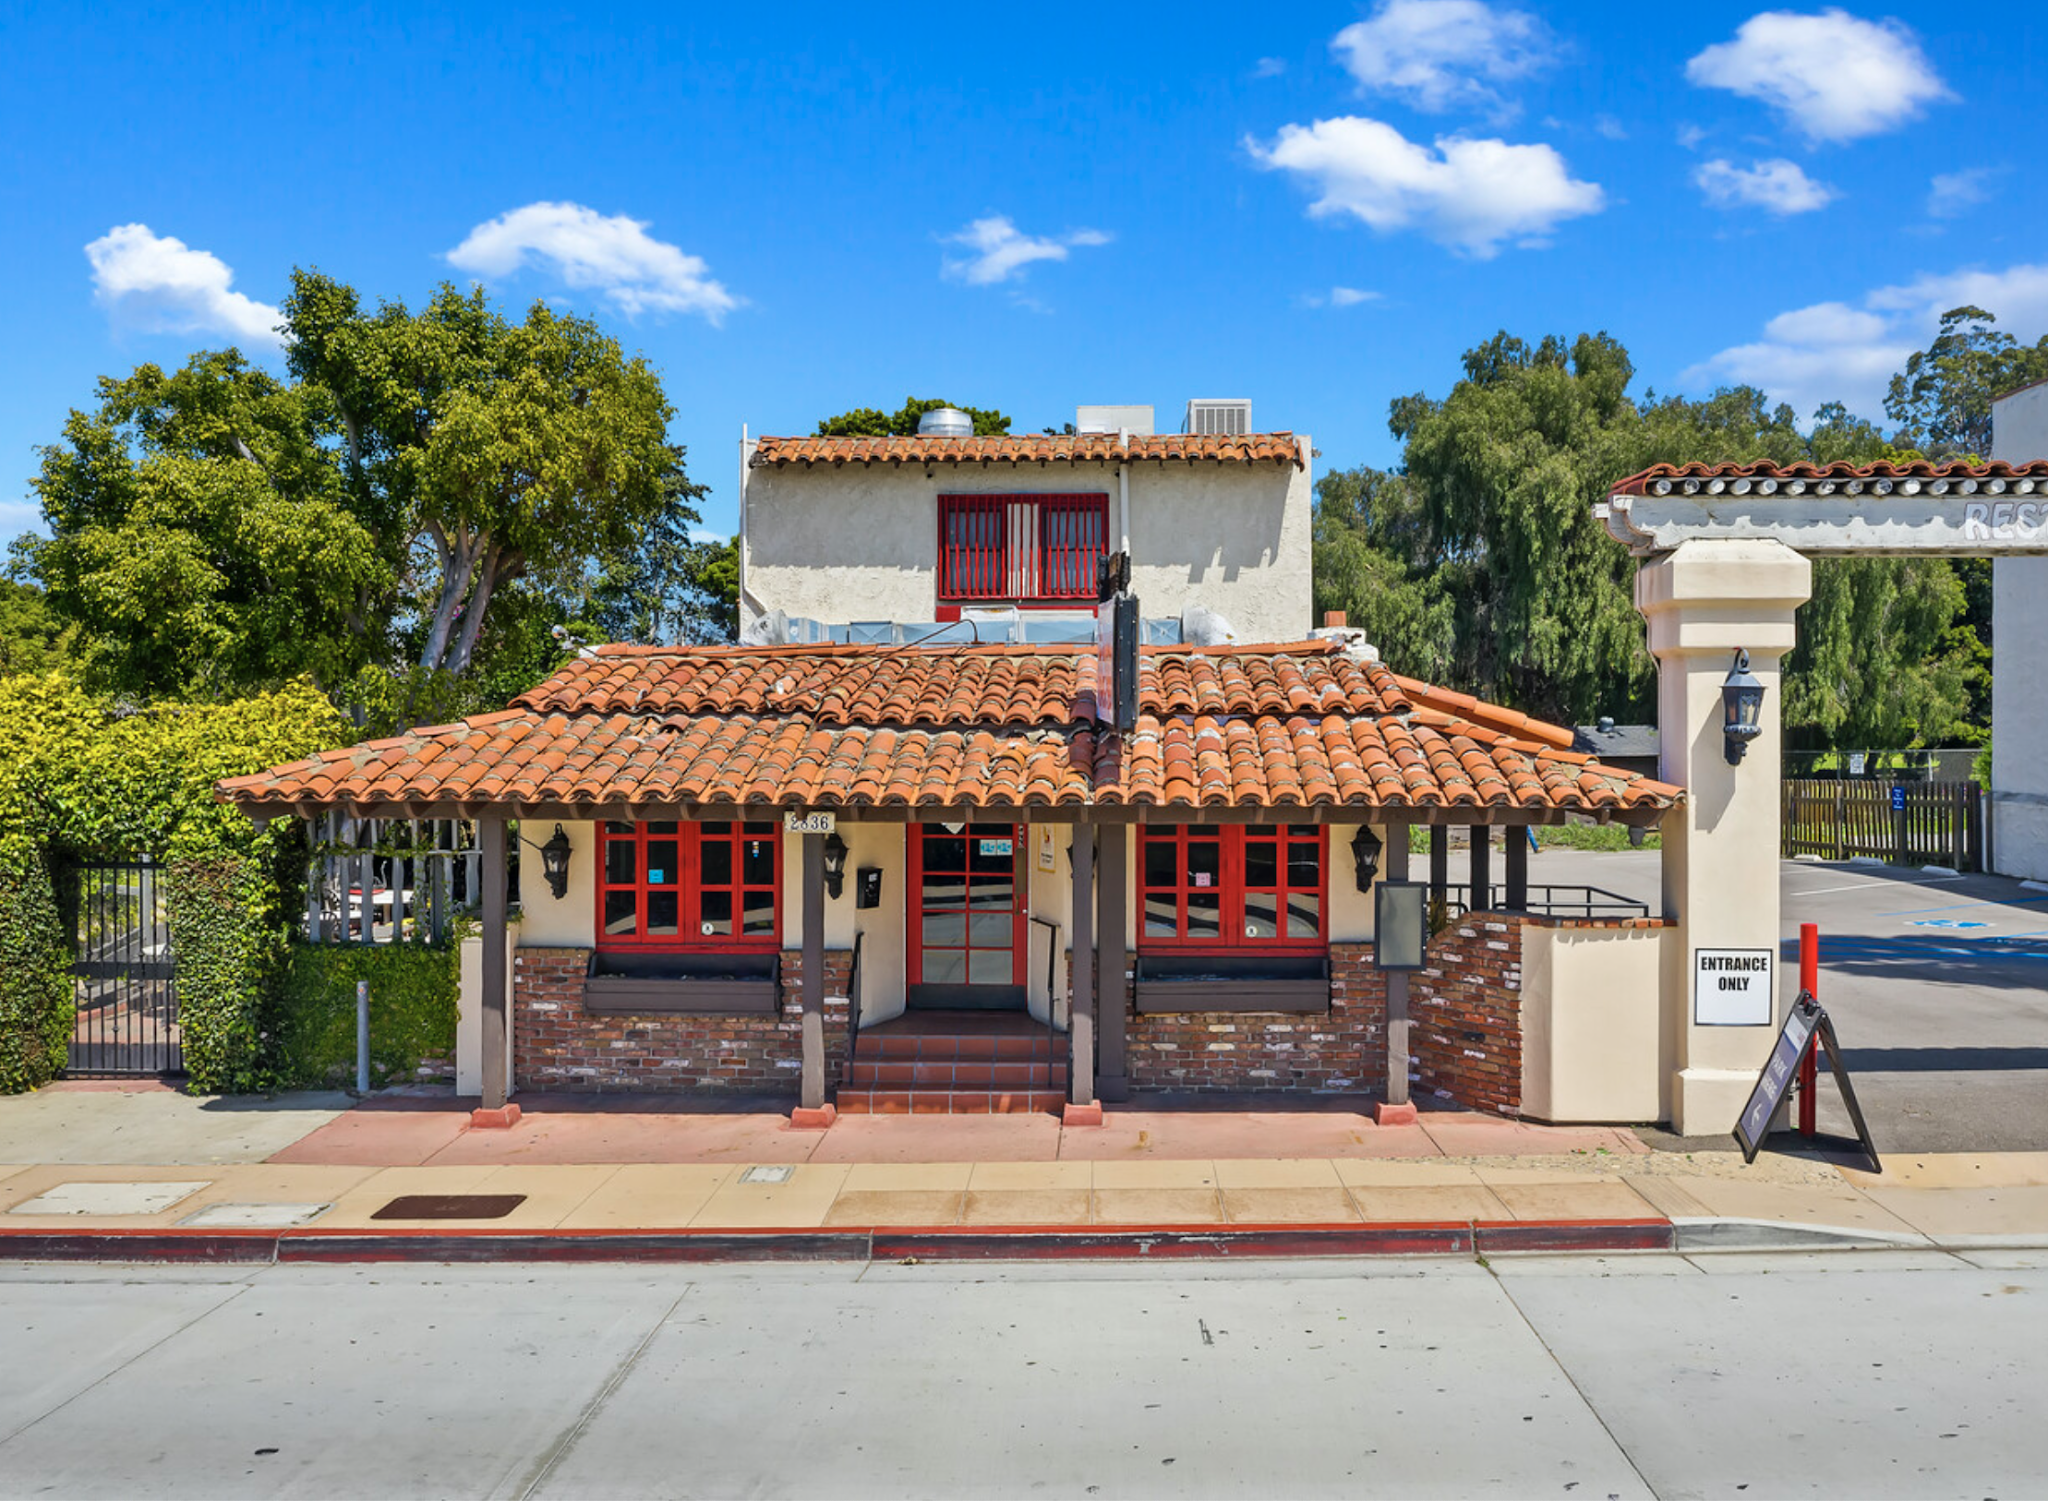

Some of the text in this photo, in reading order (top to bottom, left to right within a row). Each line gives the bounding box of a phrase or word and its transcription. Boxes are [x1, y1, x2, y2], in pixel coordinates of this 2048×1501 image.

[1964, 502, 2048, 540] RES
[790, 815, 829, 830] 2836
[1701, 957, 1768, 972] ENTRANCE
[1718, 976, 1750, 991] ONLY
